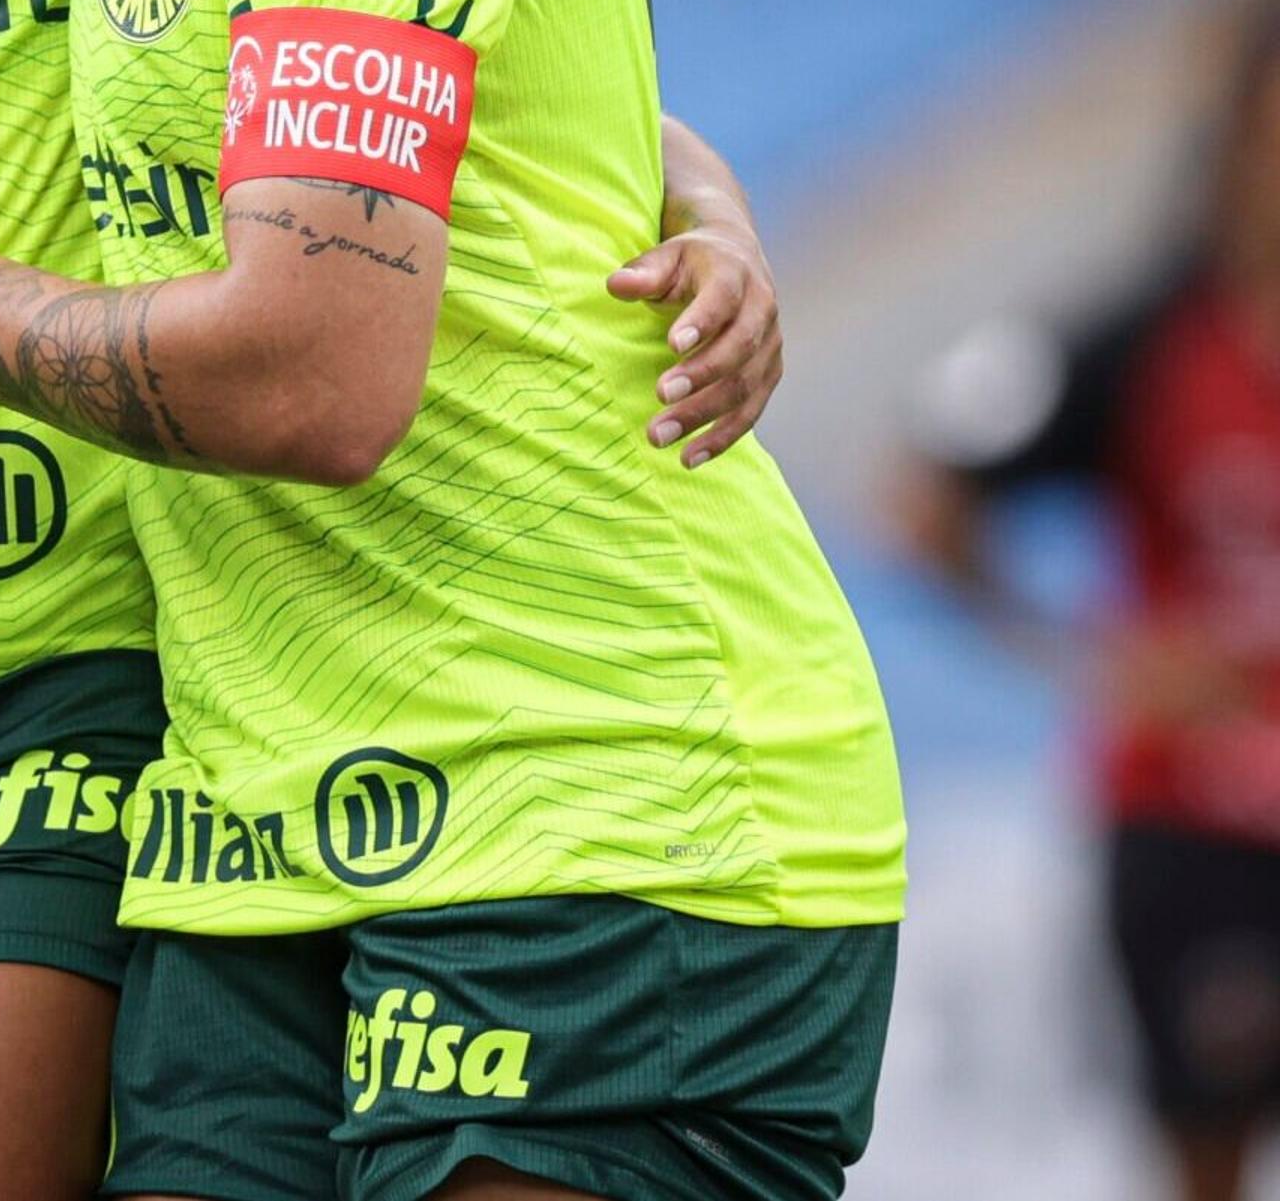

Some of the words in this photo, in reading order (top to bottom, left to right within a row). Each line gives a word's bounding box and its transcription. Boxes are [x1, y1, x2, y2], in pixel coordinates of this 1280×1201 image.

[272, 40, 456, 125] ESCOLHA
[263, 99, 428, 174] INCLUIR
[303, 235, 419, 275] jornada
